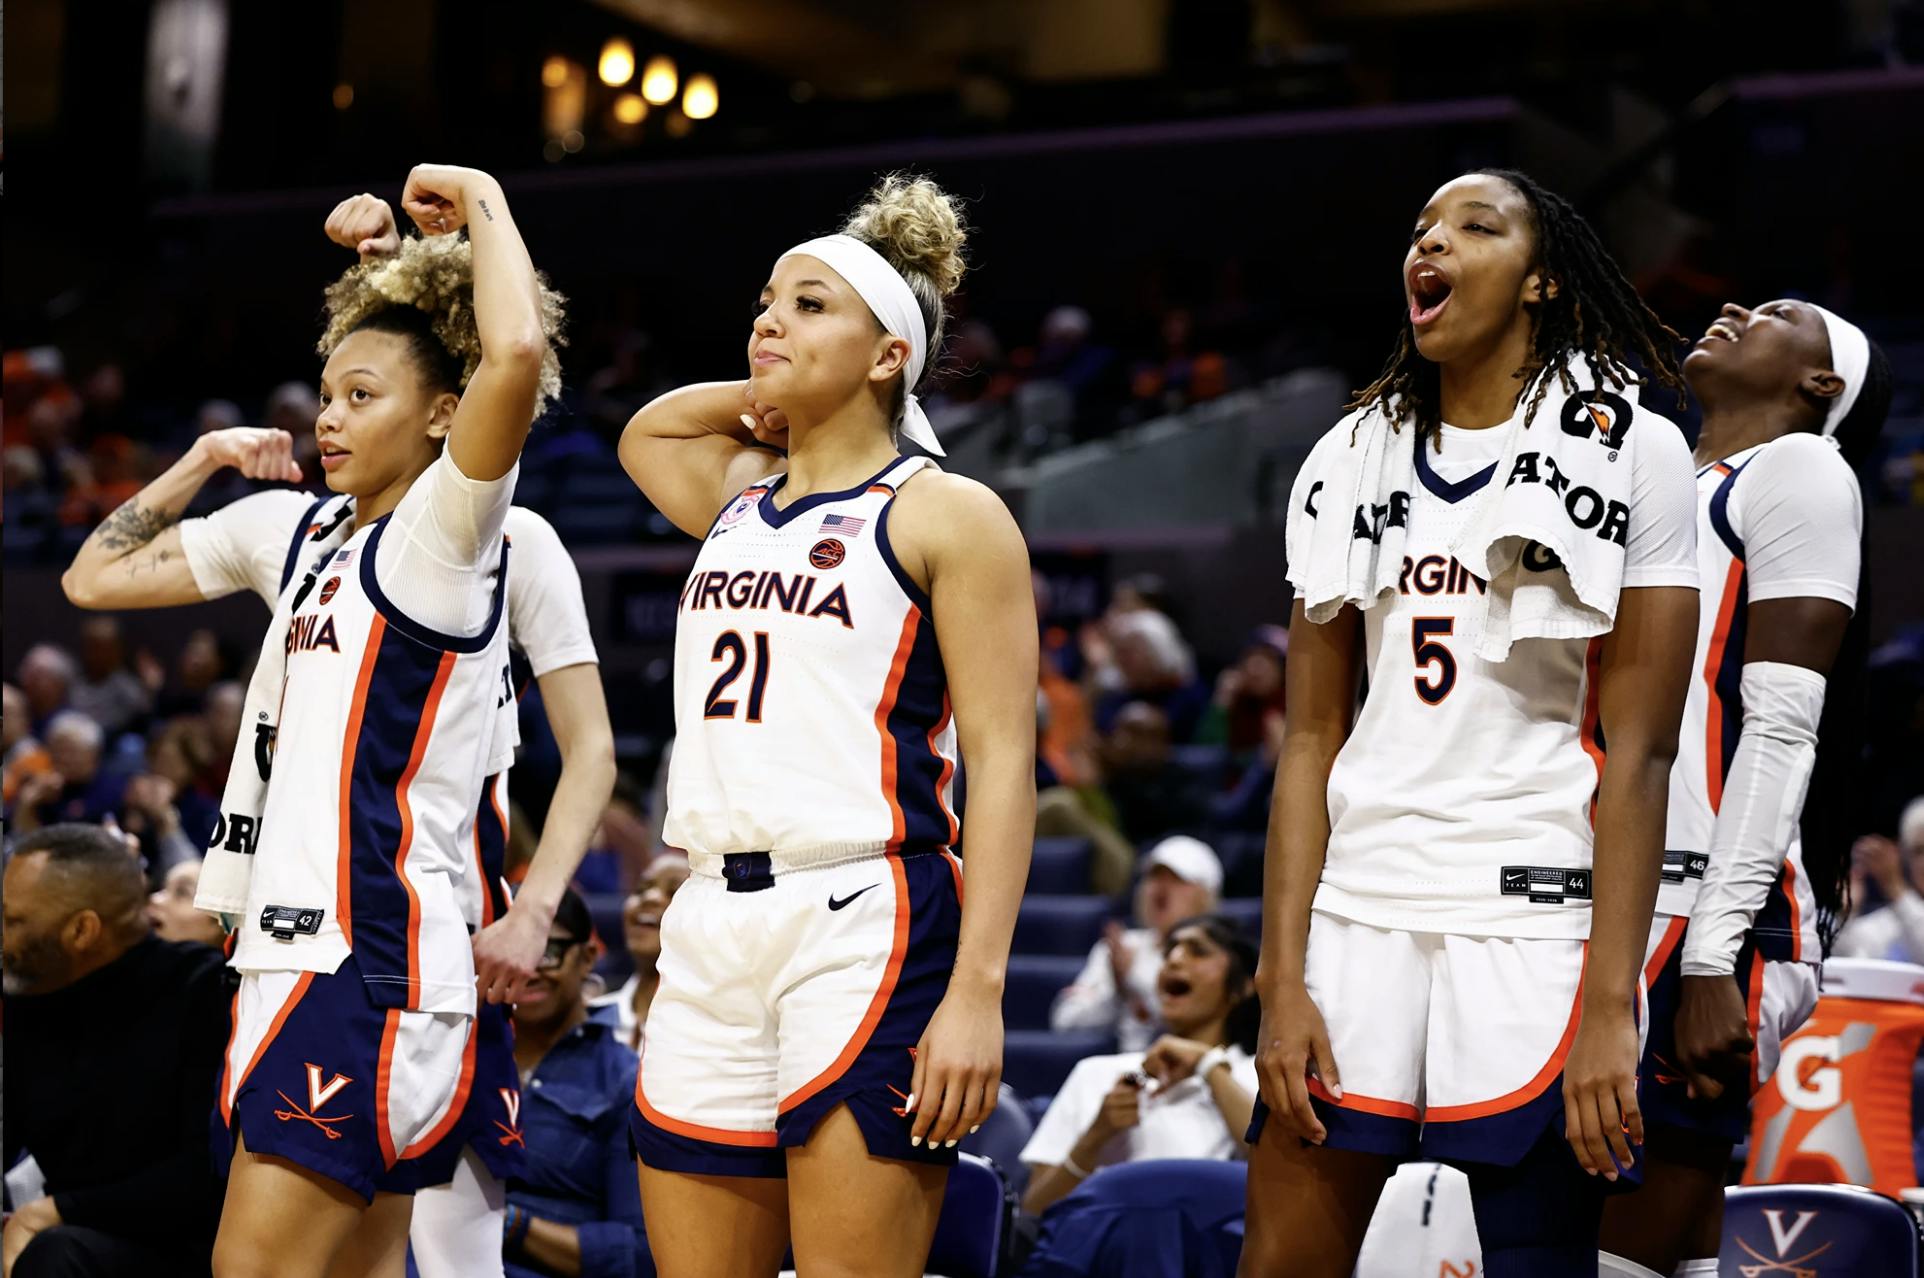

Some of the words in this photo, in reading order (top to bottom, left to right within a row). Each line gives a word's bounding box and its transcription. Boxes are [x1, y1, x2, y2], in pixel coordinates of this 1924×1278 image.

[680, 570, 855, 630] VIRGINIA
[703, 629, 770, 724] 21
[1412, 616, 1458, 706] 5
[1569, 877, 1584, 890] 44
[1689, 859, 1705, 871] 46
[299, 915, 312, 927] 42
[304, 1062, 353, 1114] V
[1776, 1035, 1843, 1111] G
[1762, 1208, 1819, 1258] V
